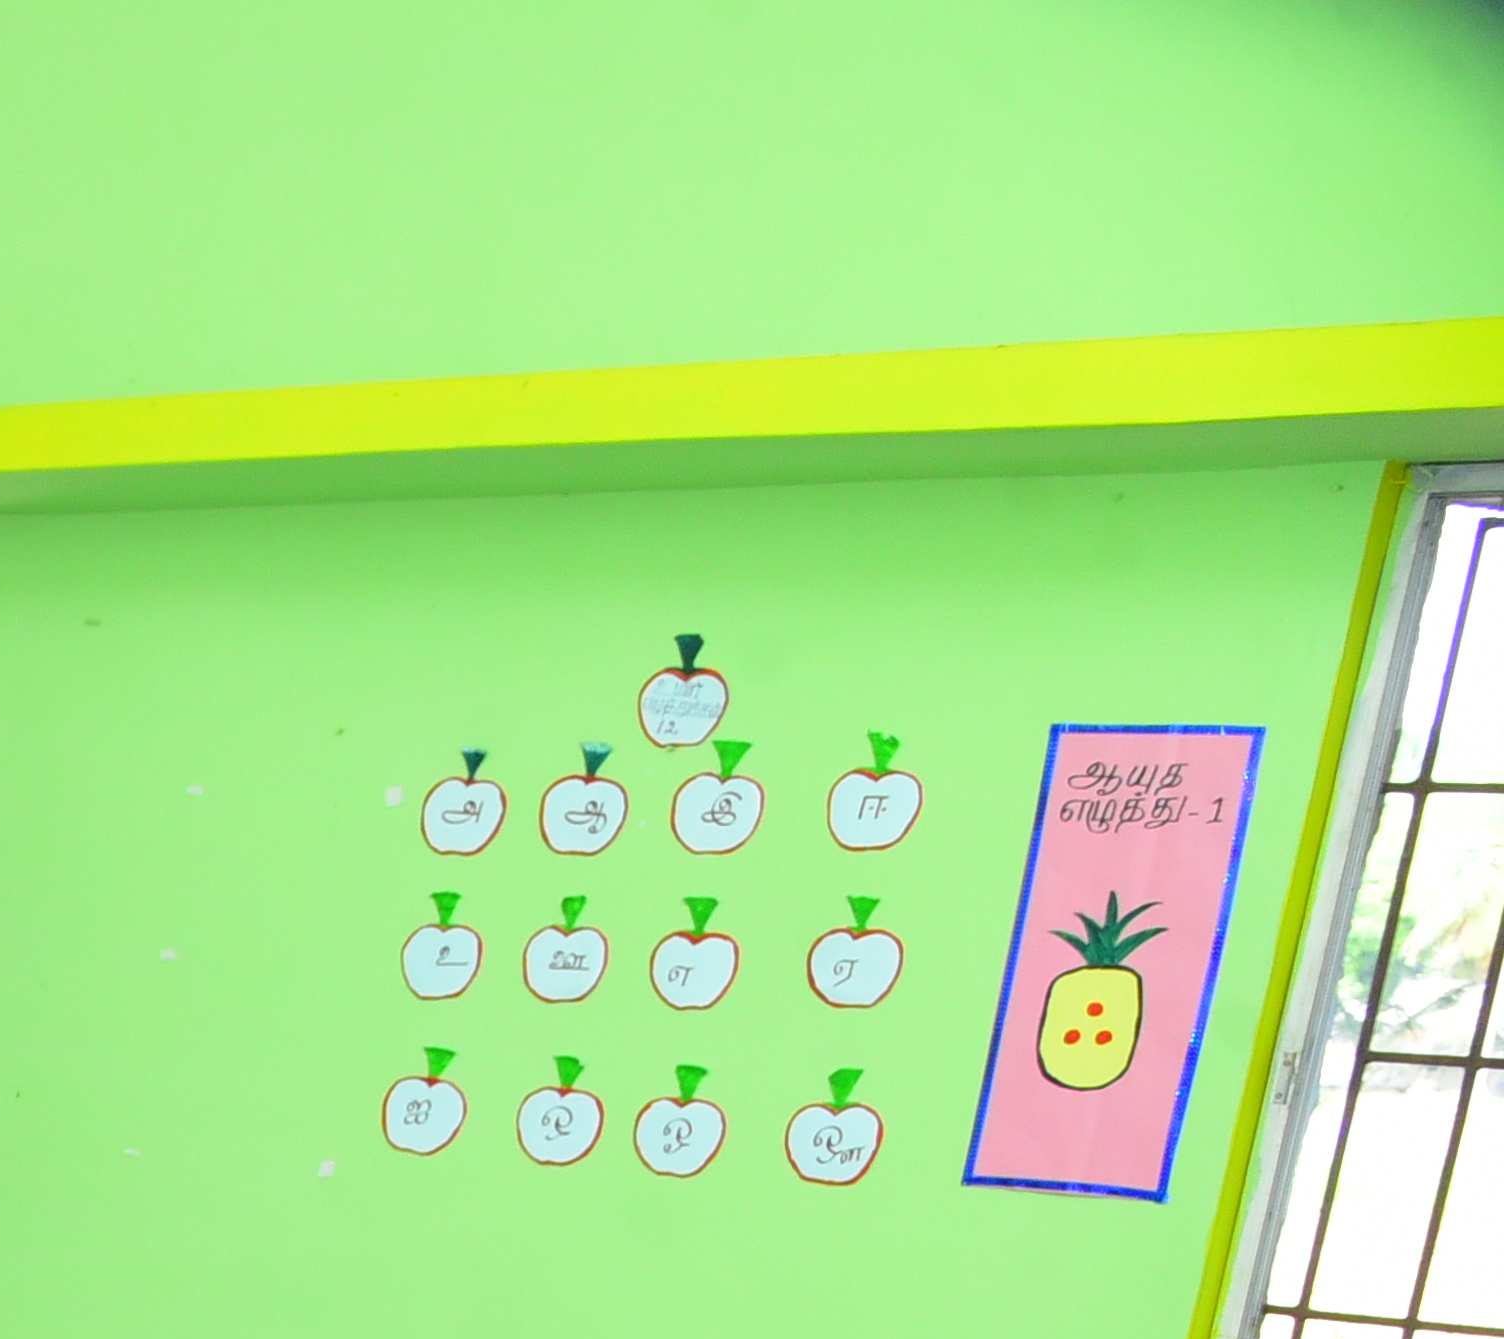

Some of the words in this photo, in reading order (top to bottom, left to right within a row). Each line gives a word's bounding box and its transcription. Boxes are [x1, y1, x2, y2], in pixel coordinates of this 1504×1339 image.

[1067, 761, 1189, 796] ஆயுத
[441, 799, 484, 824] அ
[565, 799, 608, 834] ஆ
[701, 791, 742, 826] இ
[435, 945, 469, 966] உ
[548, 951, 590, 970] ஊ
[667, 965, 695, 987] எ
[833, 958, 859, 987] ஏ
[403, 1098, 432, 1125] ஐ
